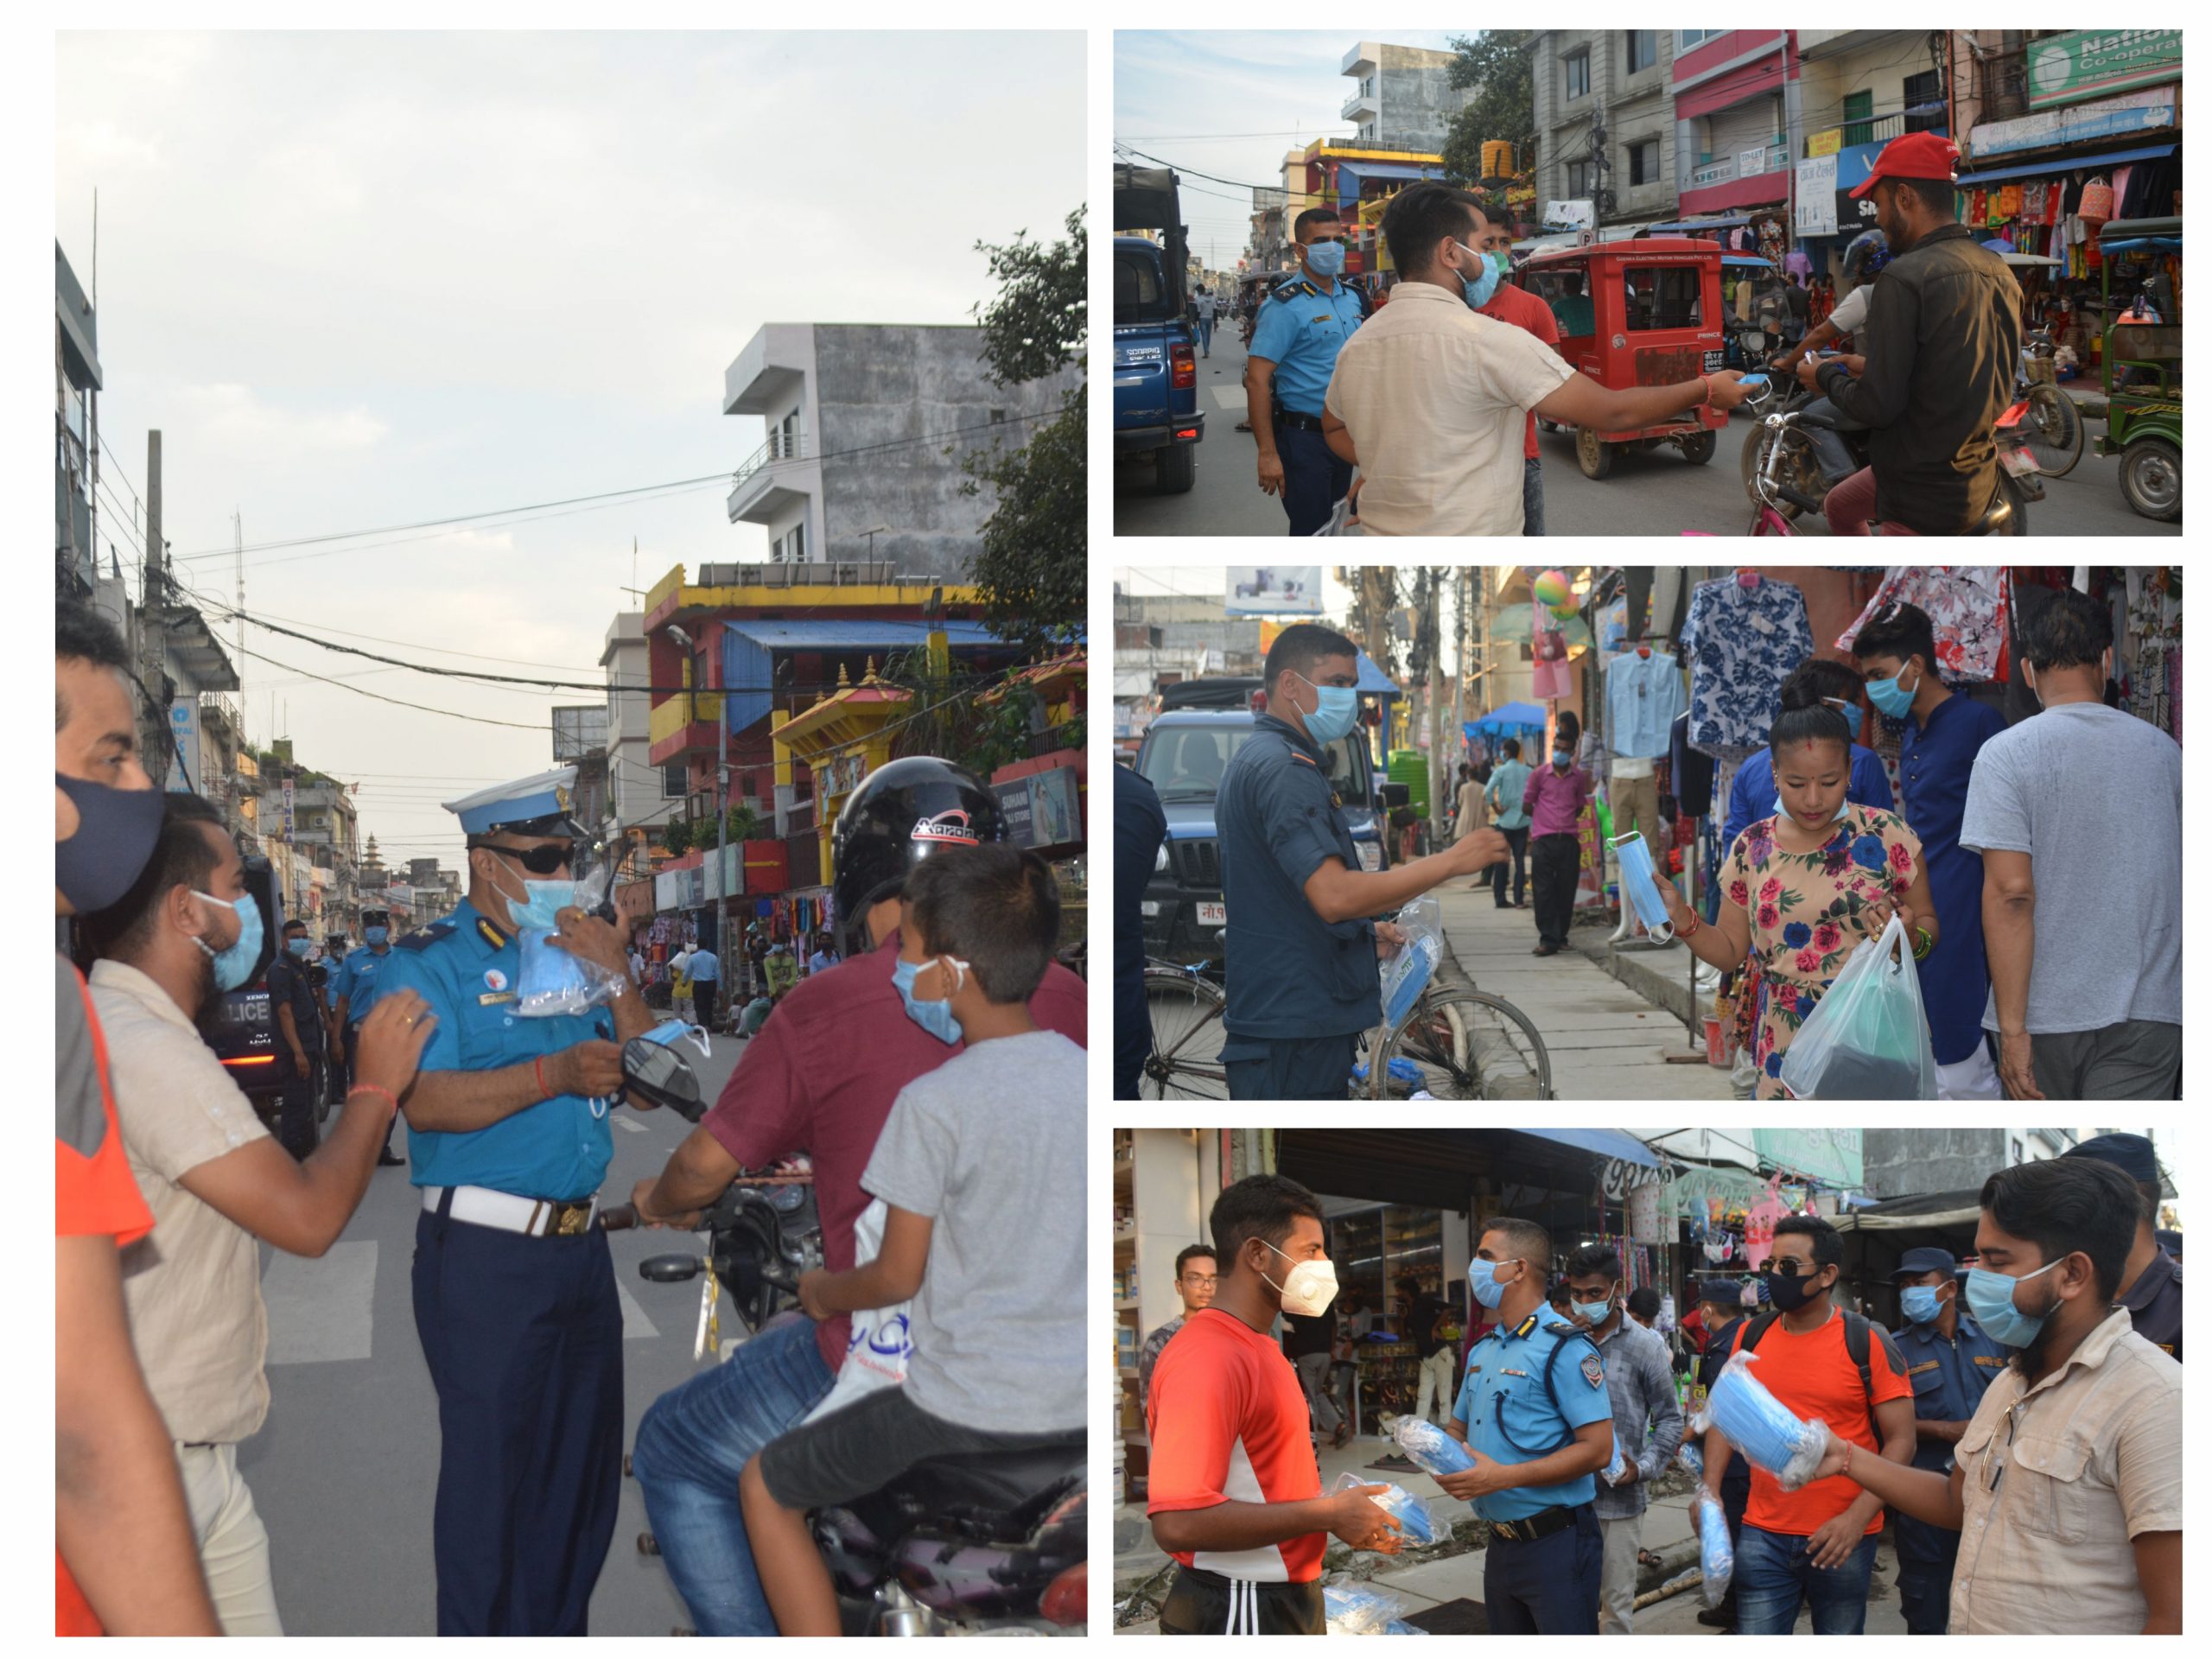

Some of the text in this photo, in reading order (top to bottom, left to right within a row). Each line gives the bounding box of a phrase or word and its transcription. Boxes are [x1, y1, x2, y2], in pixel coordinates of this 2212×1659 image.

[2081, 29, 2180, 58] Natio
[1127, 347, 1160, 356] SCORPIO
[283, 789, 293, 843] CINEMA
[228, 1002, 270, 1021] LICE
